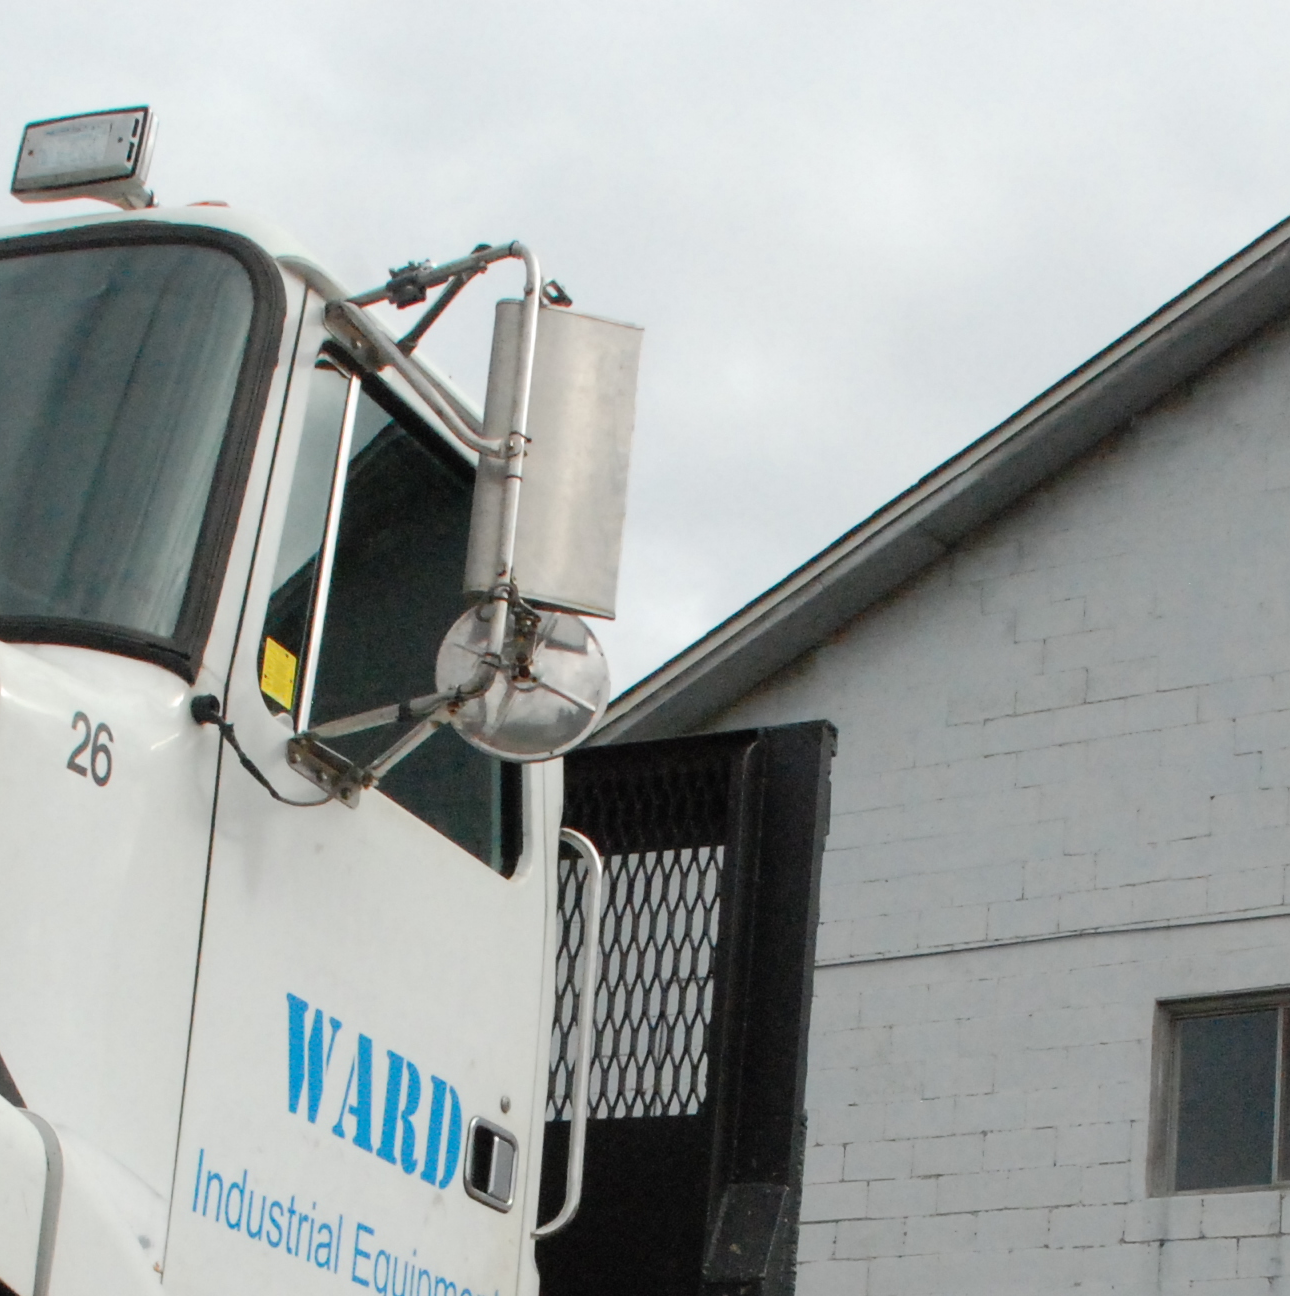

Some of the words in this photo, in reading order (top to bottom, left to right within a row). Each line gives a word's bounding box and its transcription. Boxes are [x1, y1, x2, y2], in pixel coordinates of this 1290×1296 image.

[66, 710, 114, 787] 26
[285, 991, 464, 1190] WARD
[191, 1147, 344, 1275] Industrial
